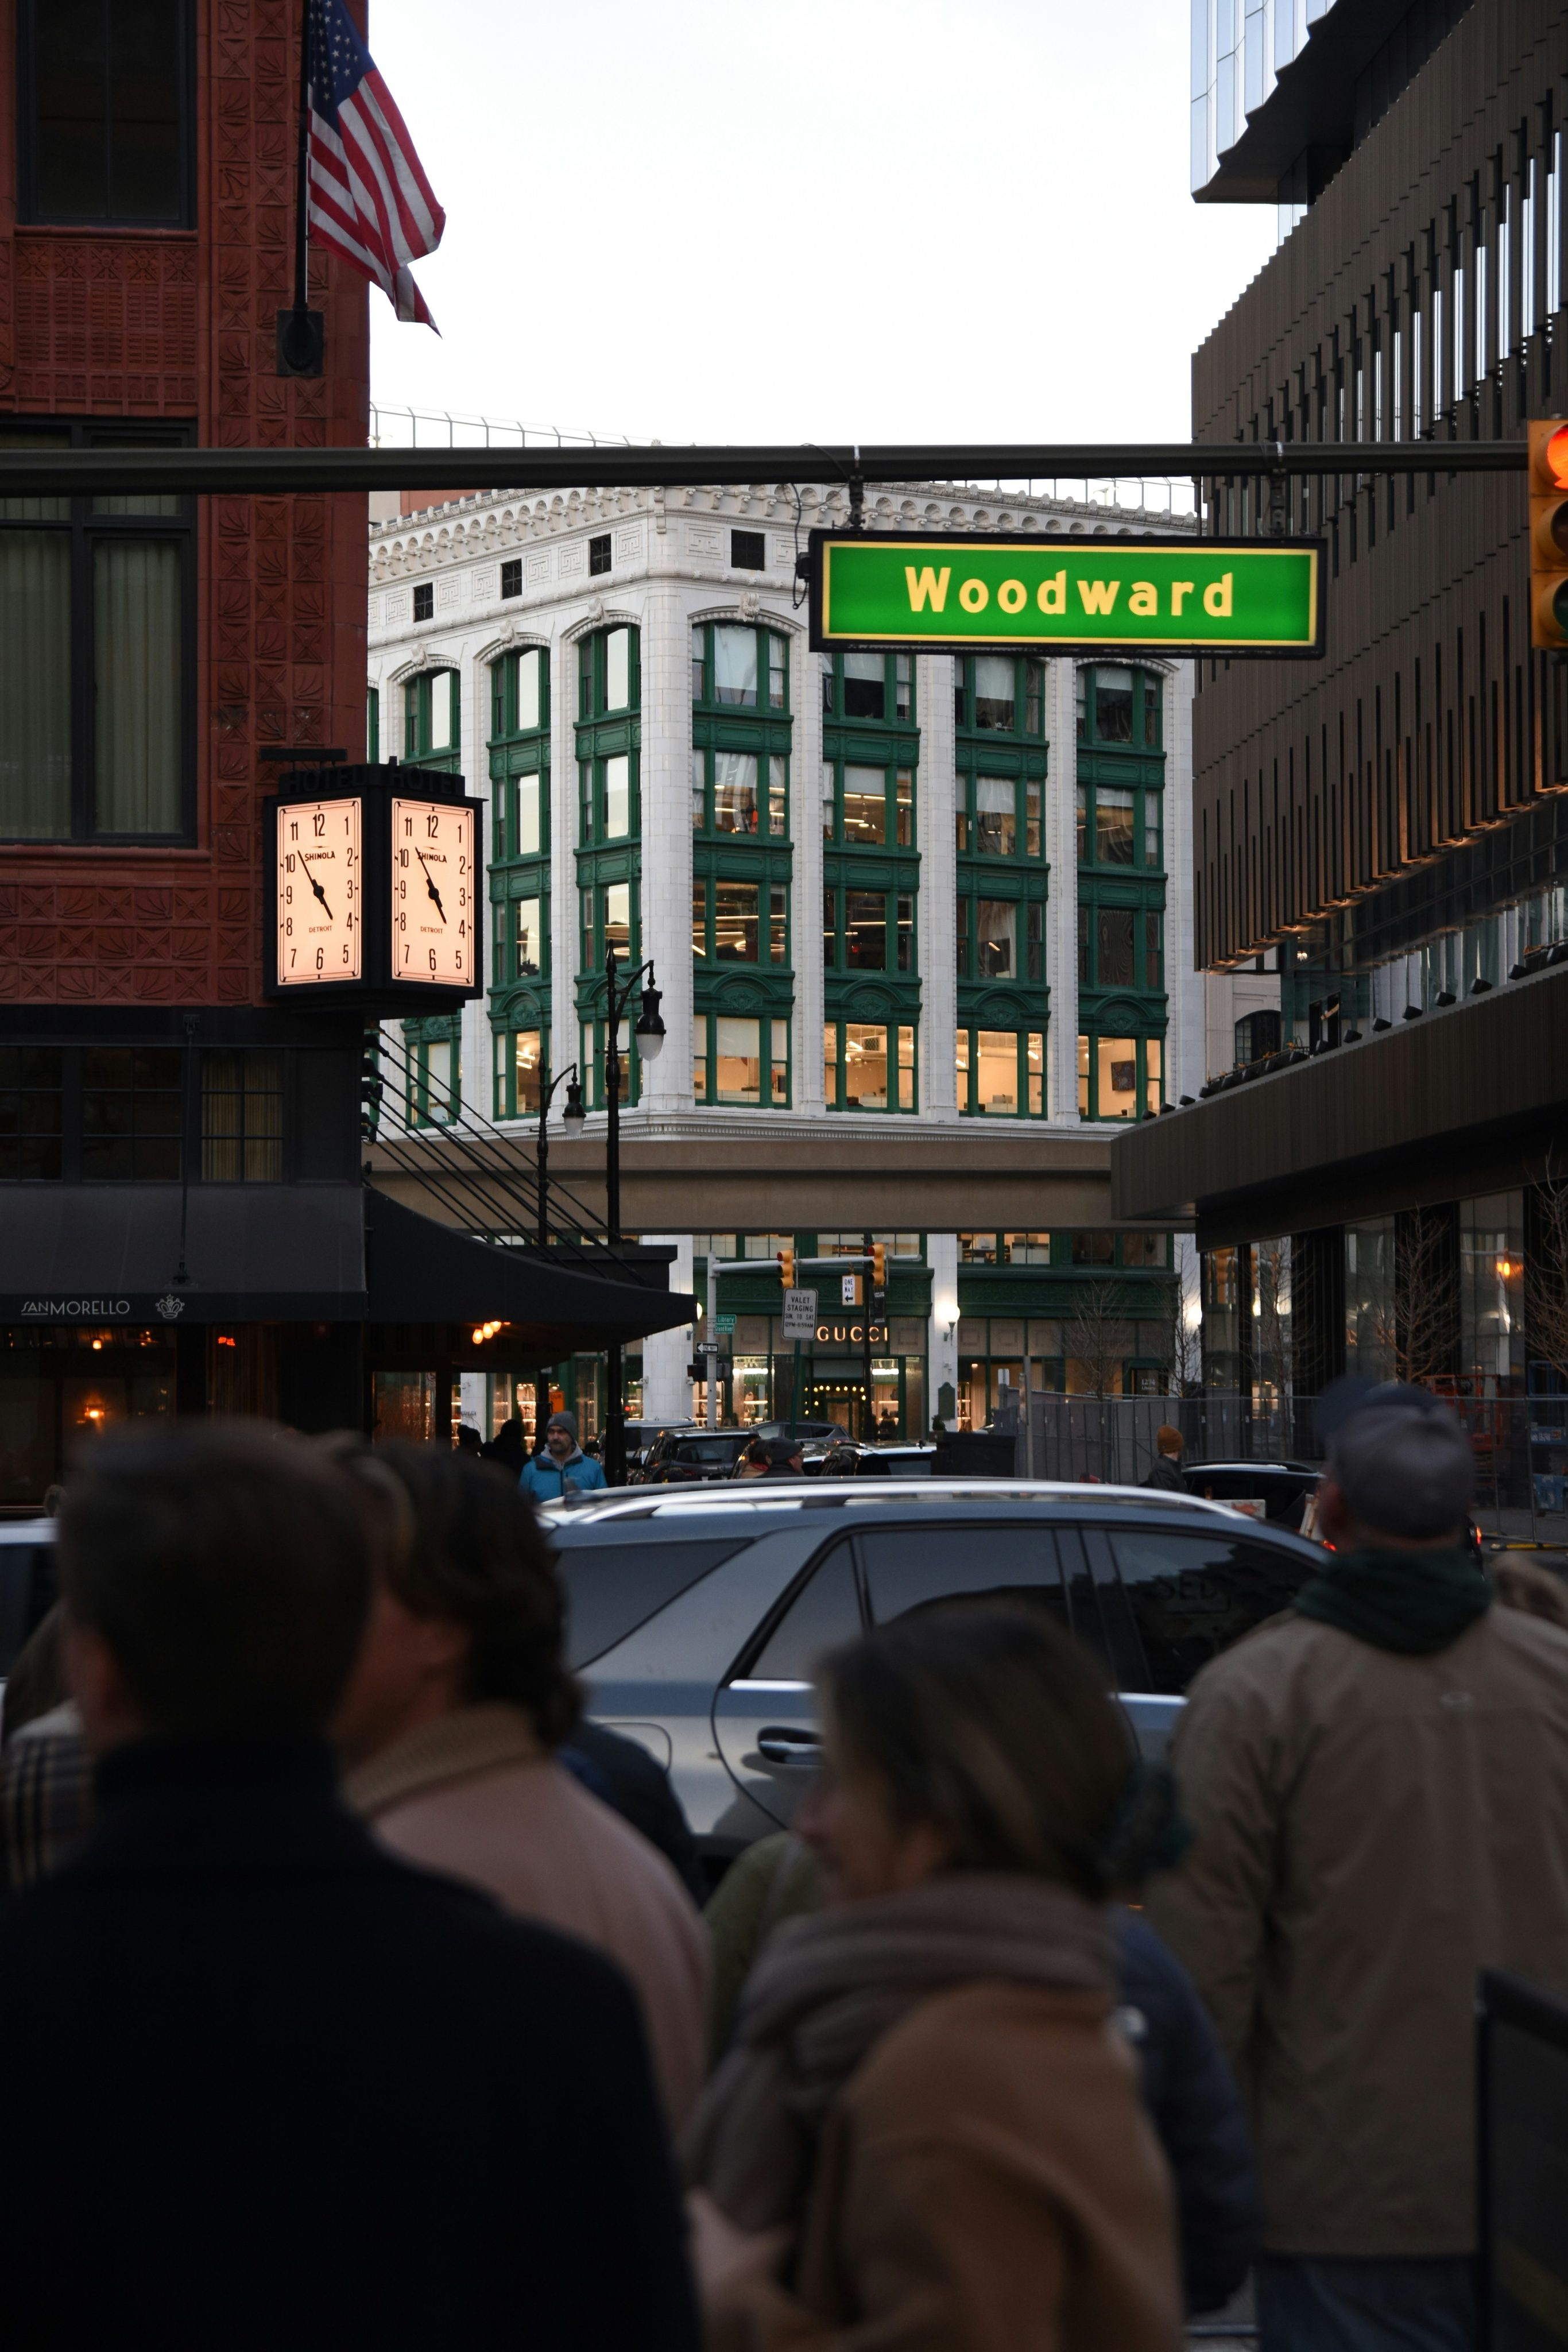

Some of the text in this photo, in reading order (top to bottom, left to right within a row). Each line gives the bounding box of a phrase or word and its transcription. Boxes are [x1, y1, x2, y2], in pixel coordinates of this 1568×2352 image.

[905, 566, 1233, 617] Woodward
[290, 821, 299, 841] 11
[312, 814, 325, 837] 12
[344, 816, 349, 835] 1
[405, 817, 412, 837] 11
[427, 814, 439, 838] 12
[458, 824, 462, 844] 1
[285, 854, 296, 873] 10
[304, 850, 335, 861] SHINOLA
[347, 848, 353, 866] 2
[400, 848, 409, 868] 10
[417, 851, 447, 863] SHINOLA
[459, 856, 466, 875] 2
[286, 885, 293, 904] 9
[347, 880, 353, 899] 3
[400, 880, 406, 899] 9
[459, 887, 466, 906] 3
[286, 917, 293, 936] 8
[309, 925, 332, 933] DETROIT
[346, 912, 353, 931] 4
[400, 912, 406, 931] 8
[420, 926, 443, 934] DETROIT
[458, 919, 466, 938] 4
[291, 949, 297, 968] 7
[316, 947, 324, 970] 6
[343, 944, 349, 964] 5
[404, 945, 411, 964] 7
[428, 949, 436, 970] 6
[455, 950, 462, 969] 5
[787, 1304, 814, 1312] STAGING
[816, 1326, 888, 1342] GUCCI
